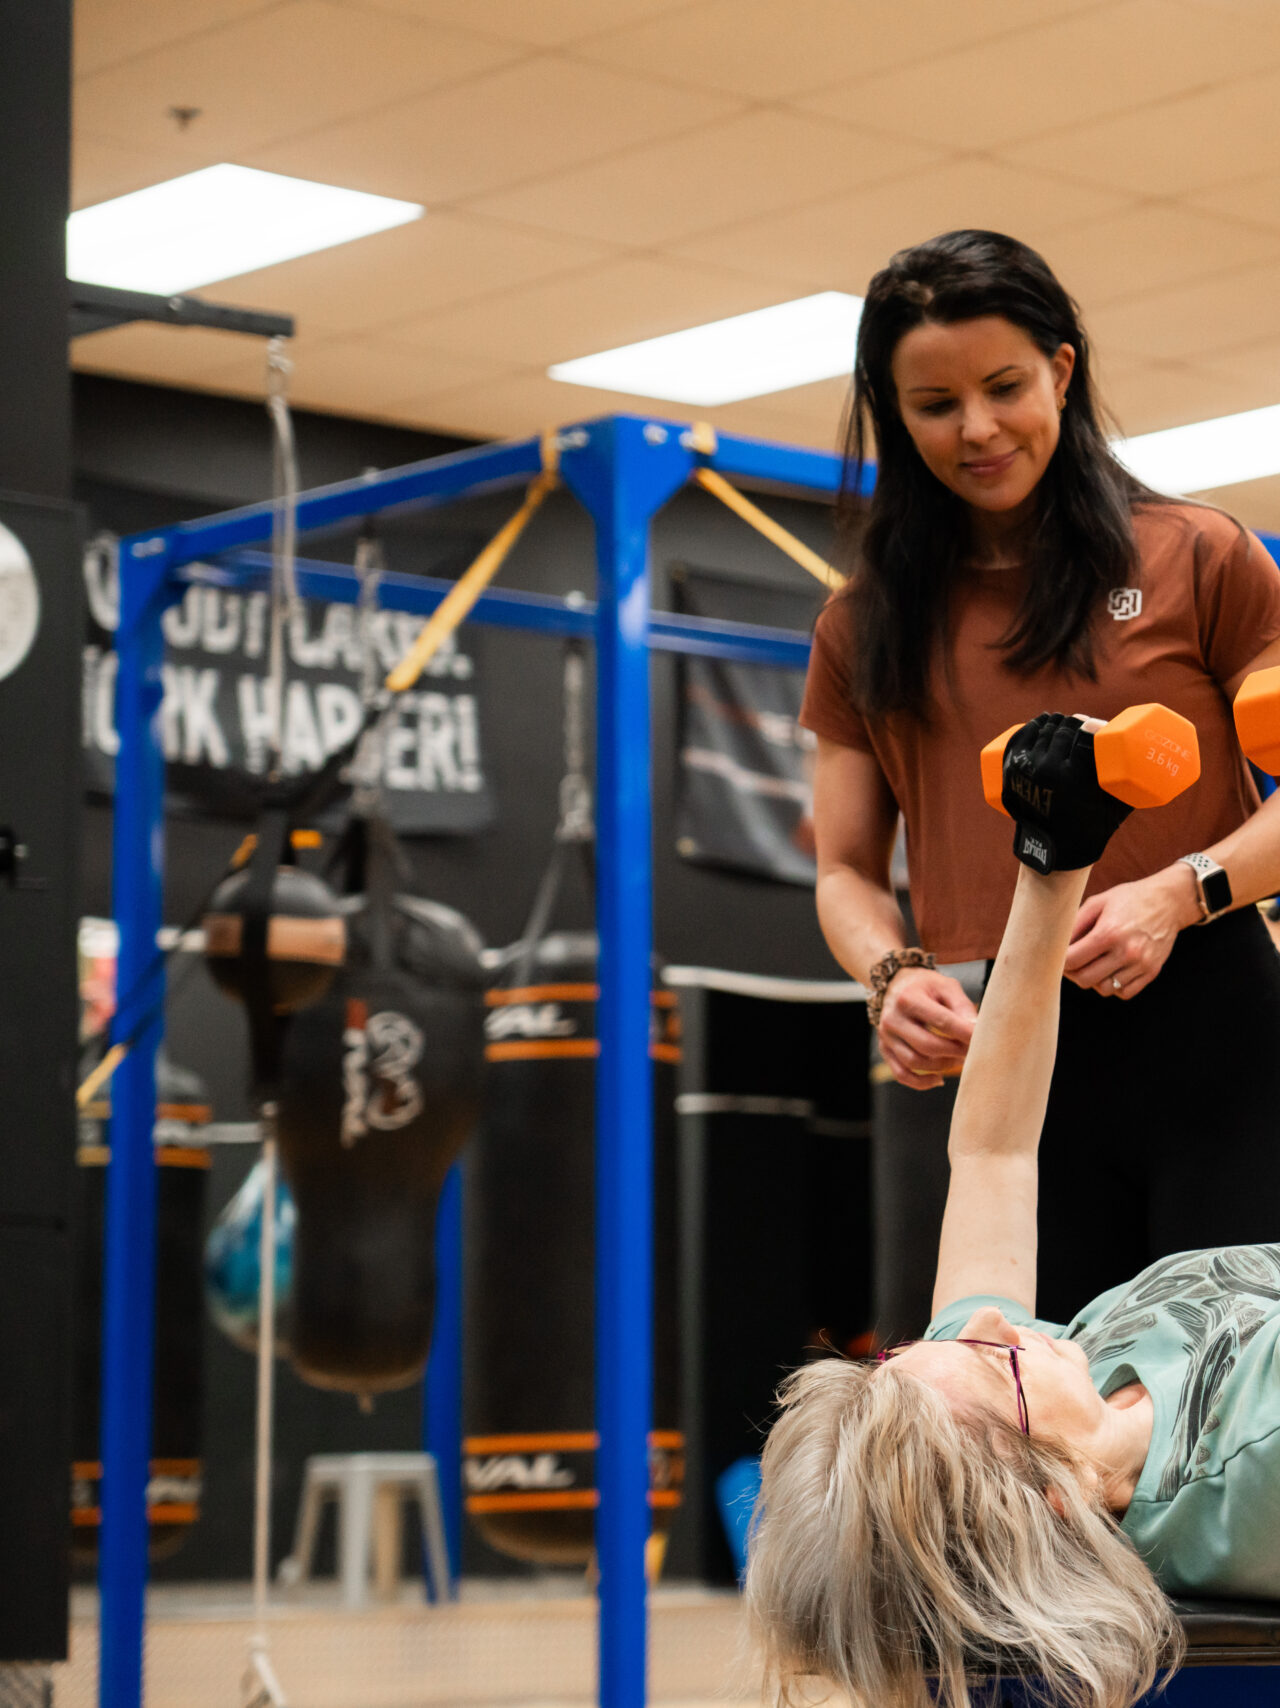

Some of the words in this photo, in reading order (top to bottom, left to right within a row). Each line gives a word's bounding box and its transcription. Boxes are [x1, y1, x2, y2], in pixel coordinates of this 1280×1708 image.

[238, 672, 483, 793] HARER!
[1145, 746, 1166, 766] 3.6
[1166, 757, 1179, 777] kg
